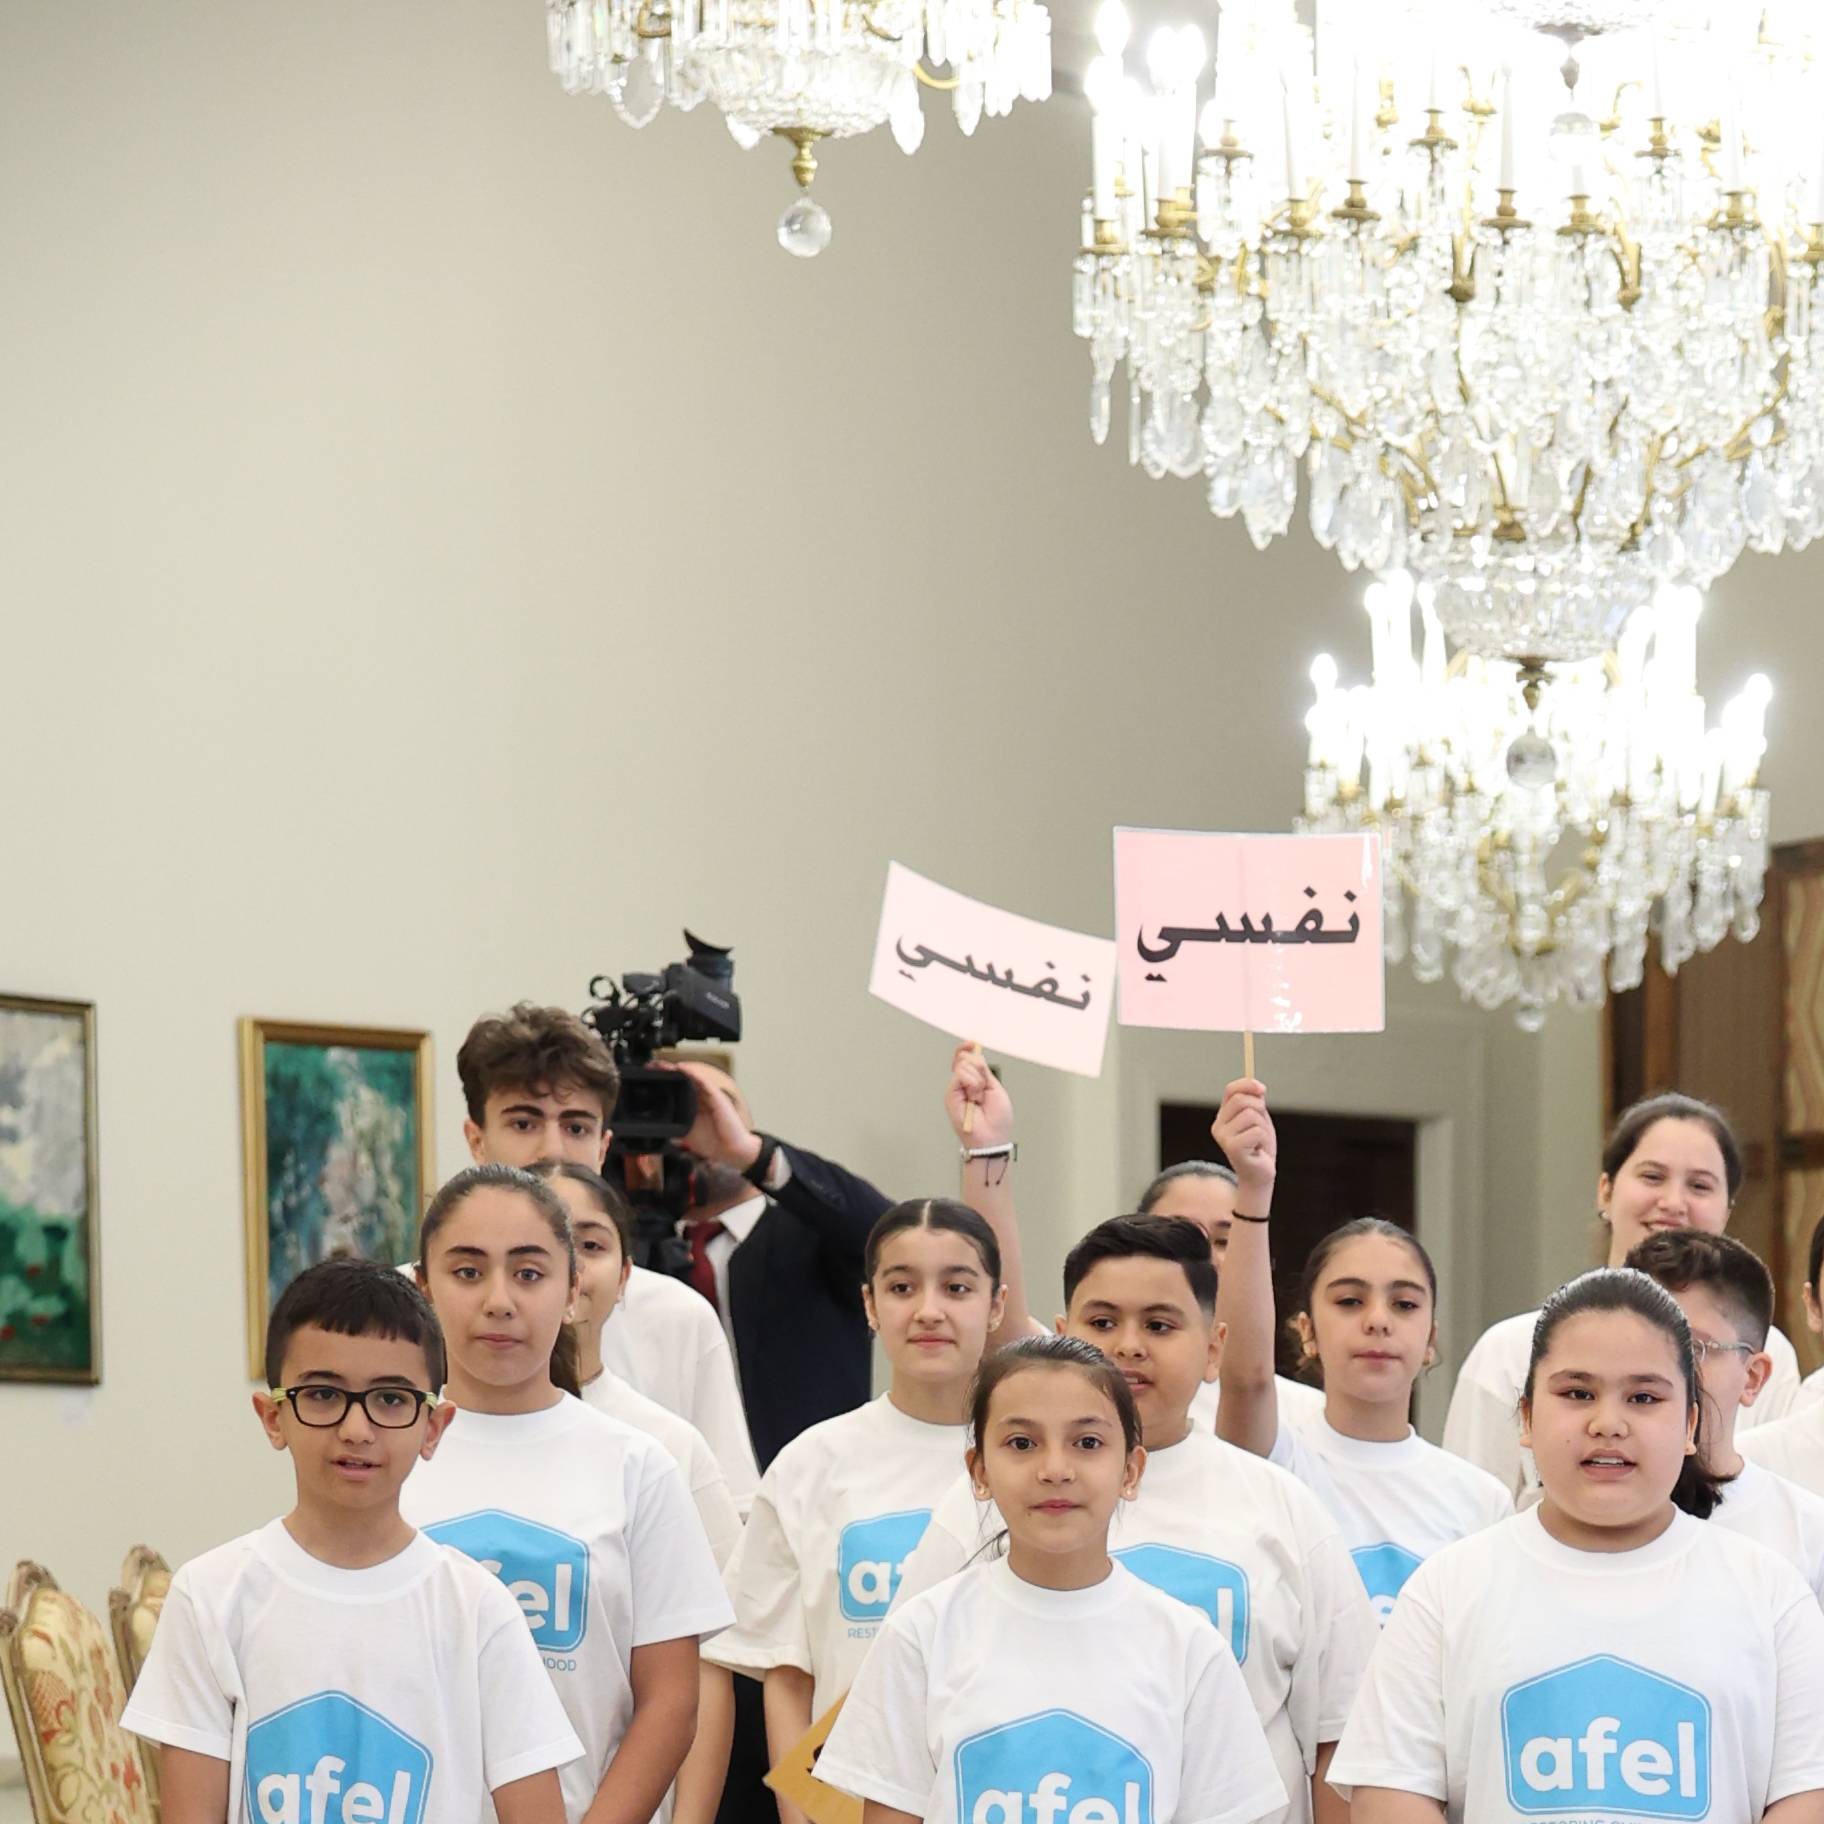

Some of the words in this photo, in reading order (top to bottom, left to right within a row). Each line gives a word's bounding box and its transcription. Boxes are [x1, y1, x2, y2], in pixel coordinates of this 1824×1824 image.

[895, 933, 1092, 1011] نفسي
[1137, 885, 1361, 982] نفسي
[1520, 1716, 1697, 1798] afel
